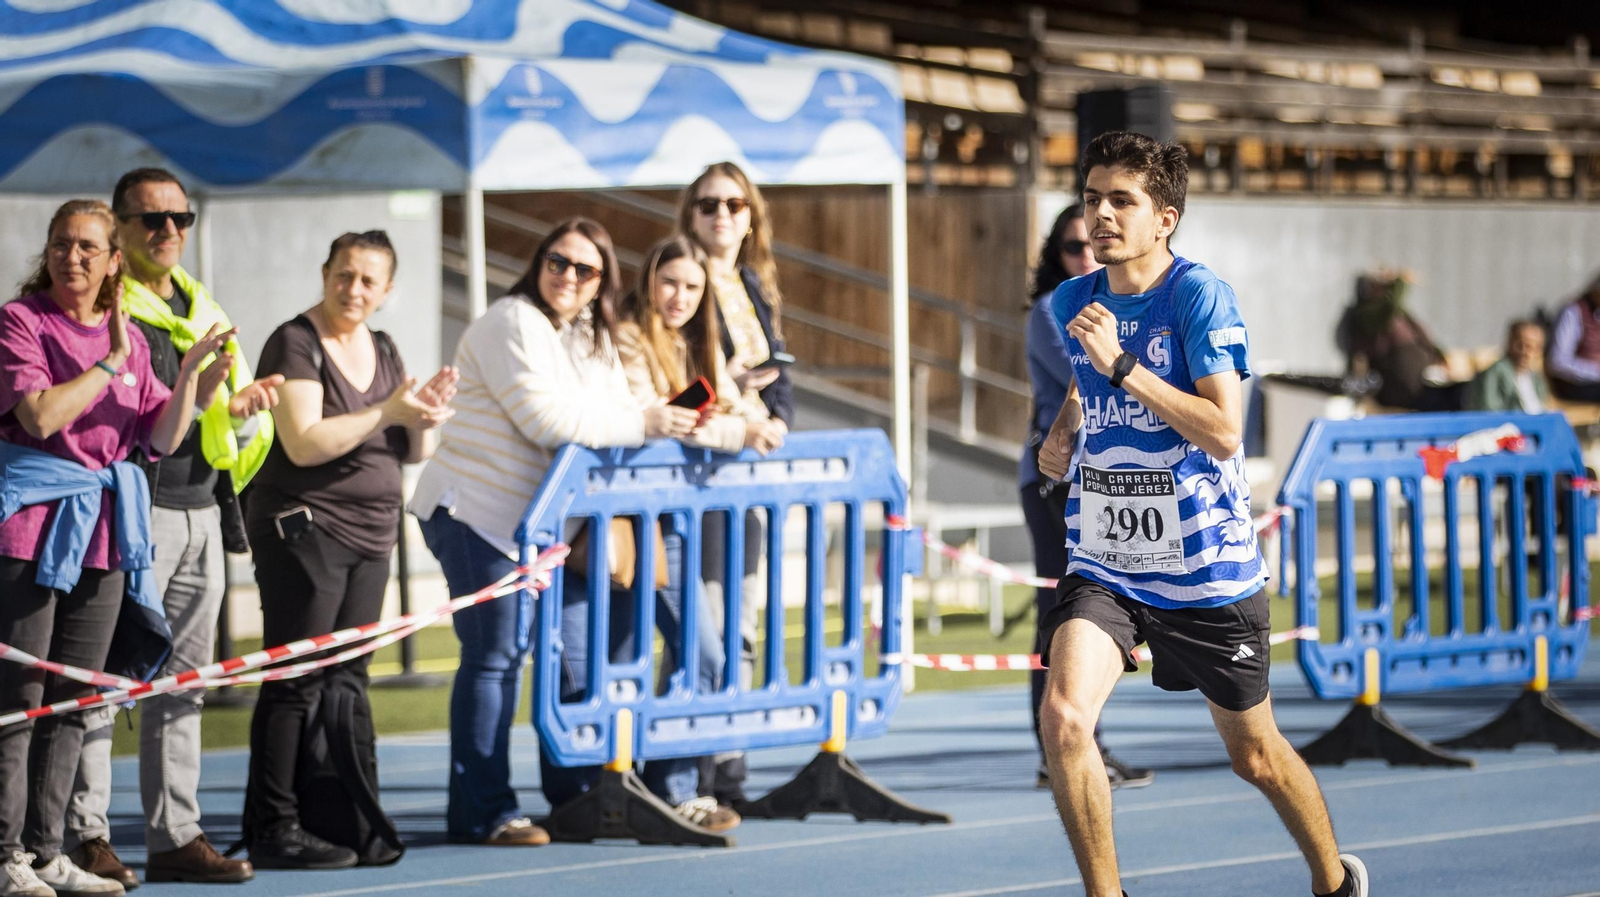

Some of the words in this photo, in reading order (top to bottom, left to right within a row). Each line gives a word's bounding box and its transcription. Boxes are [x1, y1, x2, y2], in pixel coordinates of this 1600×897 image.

[1108, 474, 1169, 484] CARRERA
[1086, 480, 1125, 494] POPULAR
[1131, 484, 1171, 494] JEREZ
[1103, 505, 1164, 543] 290
